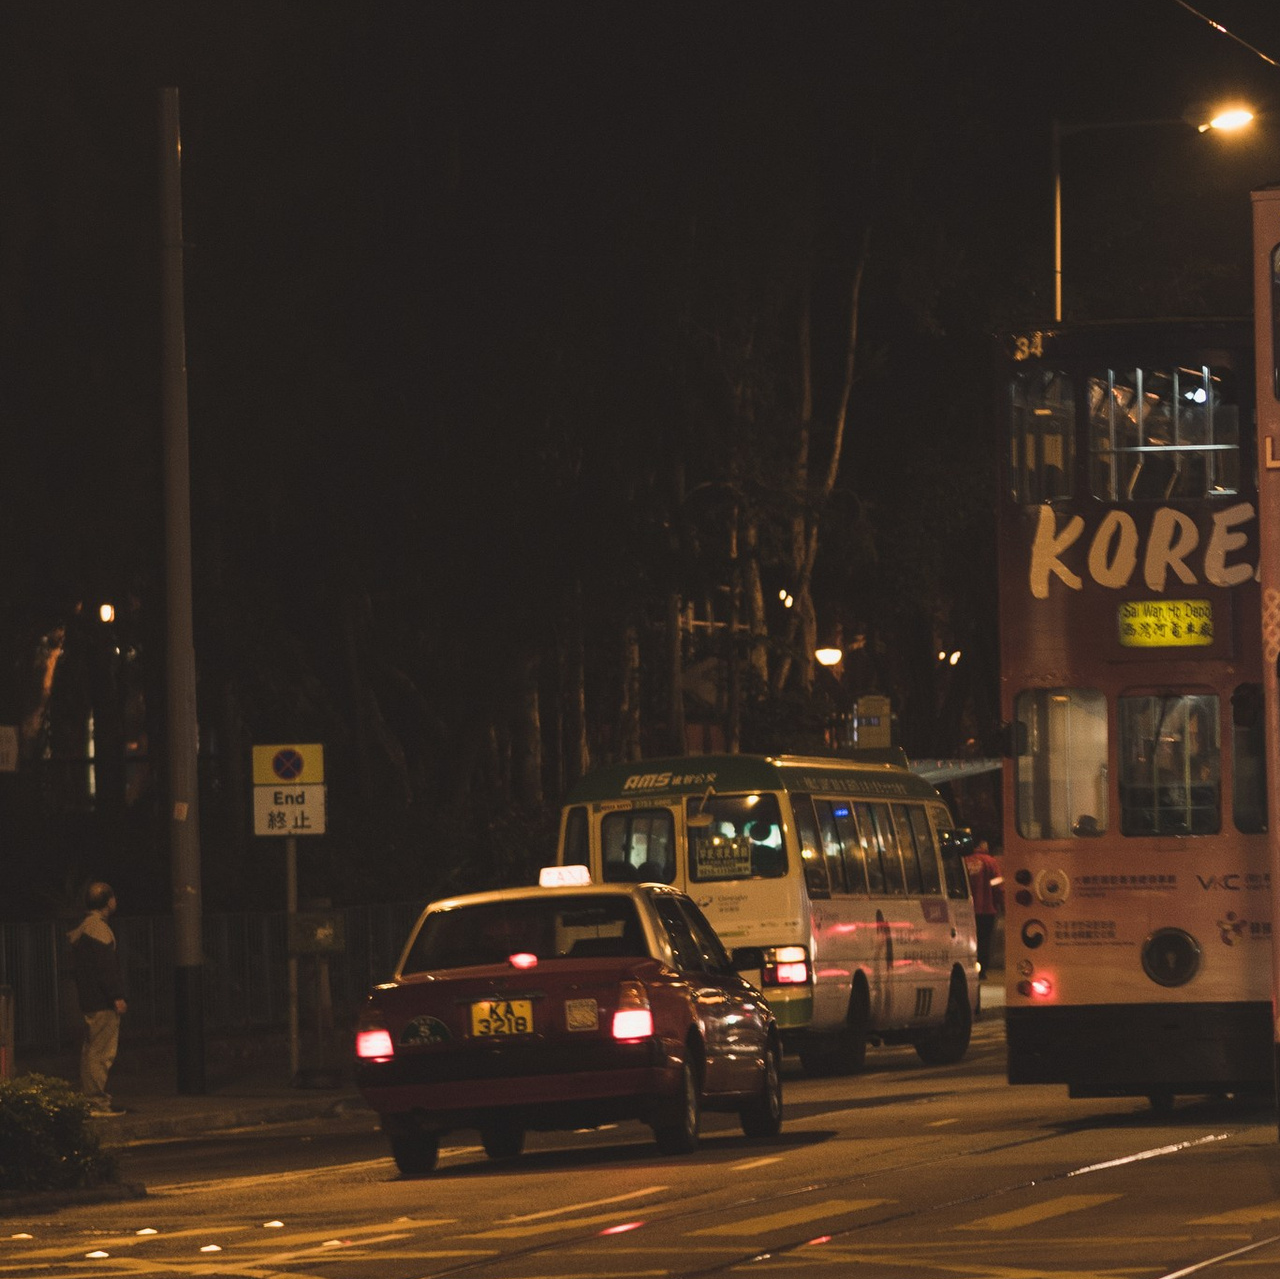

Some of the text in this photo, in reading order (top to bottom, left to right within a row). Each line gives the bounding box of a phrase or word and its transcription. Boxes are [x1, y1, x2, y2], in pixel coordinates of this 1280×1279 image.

[1029, 501, 1261, 600] KORE
[273, 790, 306, 806] End
[267, 811, 312, 830] 終止
[489, 1002, 516, 1018] KA
[478, 1017, 528, 1036] 3218
